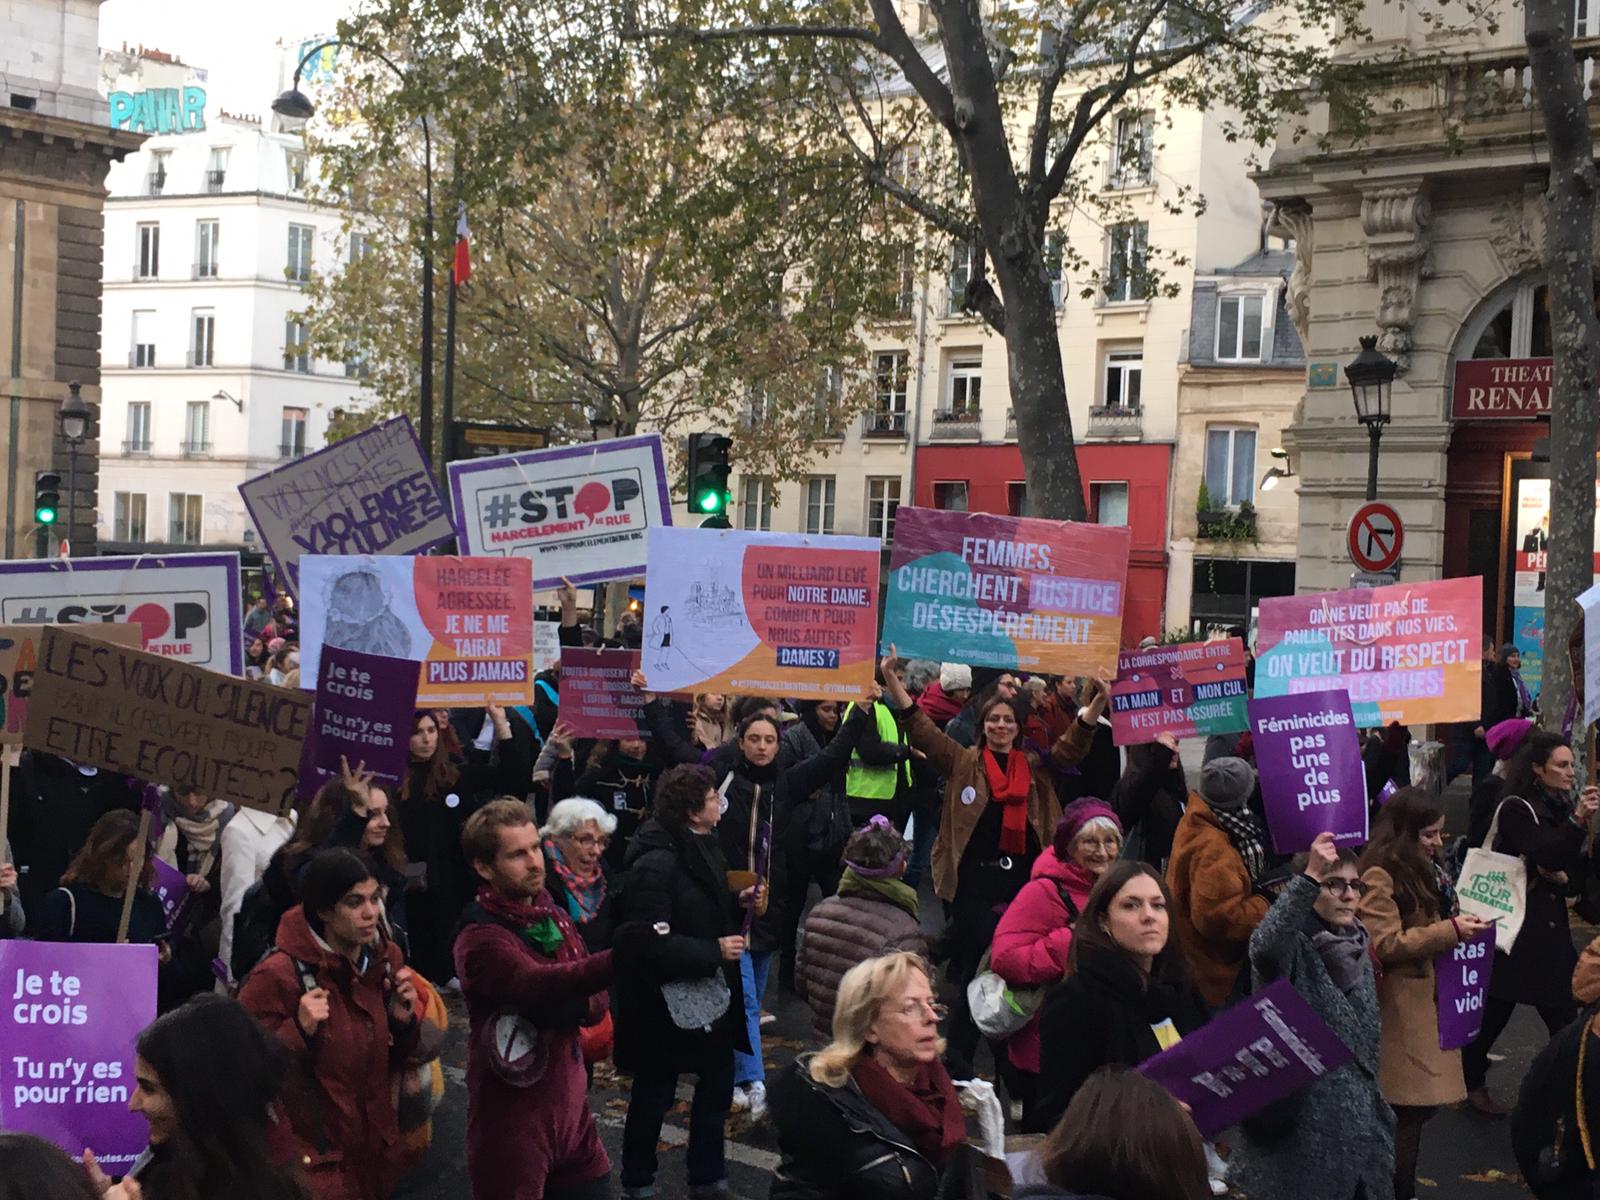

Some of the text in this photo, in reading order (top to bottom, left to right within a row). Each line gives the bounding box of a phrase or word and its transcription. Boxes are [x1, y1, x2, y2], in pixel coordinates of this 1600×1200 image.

[291, 470, 432, 554] VIOLENCES
[491, 519, 586, 543] HARCELEMENT
[606, 513, 632, 526] RUE
[960, 536, 1056, 574] FEMMES,
[756, 563, 776, 580] UN
[777, 564, 837, 582] MILLIARD
[752, 585, 871, 607] POUR NOTRE DAME,
[897, 565, 1117, 613] CHERCHENT JUSTICE
[444, 614, 510, 634] JE NE ME
[764, 606, 857, 625] COMBIEN POUR
[1308, 598, 1429, 625] ON NE VEUT PAS DE
[767, 627, 852, 647] NOUS AUTRES
[1283, 615, 1459, 647] PAILLETTES DANS NOS VIES,
[161, 643, 193, 656] RUE
[452, 637, 502, 658] TAIRAI
[781, 648, 826, 667] DAMES
[1119, 644, 1232, 670] LA CORRESPONDANCE ENTRE
[1267, 638, 1470, 679] ON VEUT DU RESPECT
[326, 662, 371, 684] Je te
[430, 661, 525, 682] PLUS JAMAIS
[1349, 675, 1383, 700] LES
[1387, 669, 1440, 699] RUES
[44, 635, 309, 741] LES VOIX DU SILENCE
[326, 680, 375, 701] crois
[1114, 679, 1245, 711] TA MAIN ET MON CUL
[324, 708, 343, 725] Tu
[373, 721, 393, 734] es
[1130, 701, 1234, 729] N'EST PAS ASSURÉE
[1257, 709, 1350, 735] Féminicides
[222, 728, 277, 762] POUR
[321, 723, 395, 747] pour rien
[1289, 733, 1326, 755] pas
[1291, 751, 1331, 769] une
[1303, 767, 1330, 787] de
[1297, 785, 1342, 812] plus
[1469, 873, 1512, 903] TOUR
[1453, 941, 1486, 961] Ras
[13, 968, 81, 1000] Je te
[1461, 964, 1479, 987] le
[13, 997, 88, 1026] crois
[1454, 987, 1484, 1015] viol
[13, 1056, 45, 1080] Tu
[92, 1061, 123, 1079] es
[14, 1079, 129, 1109] pour rien
